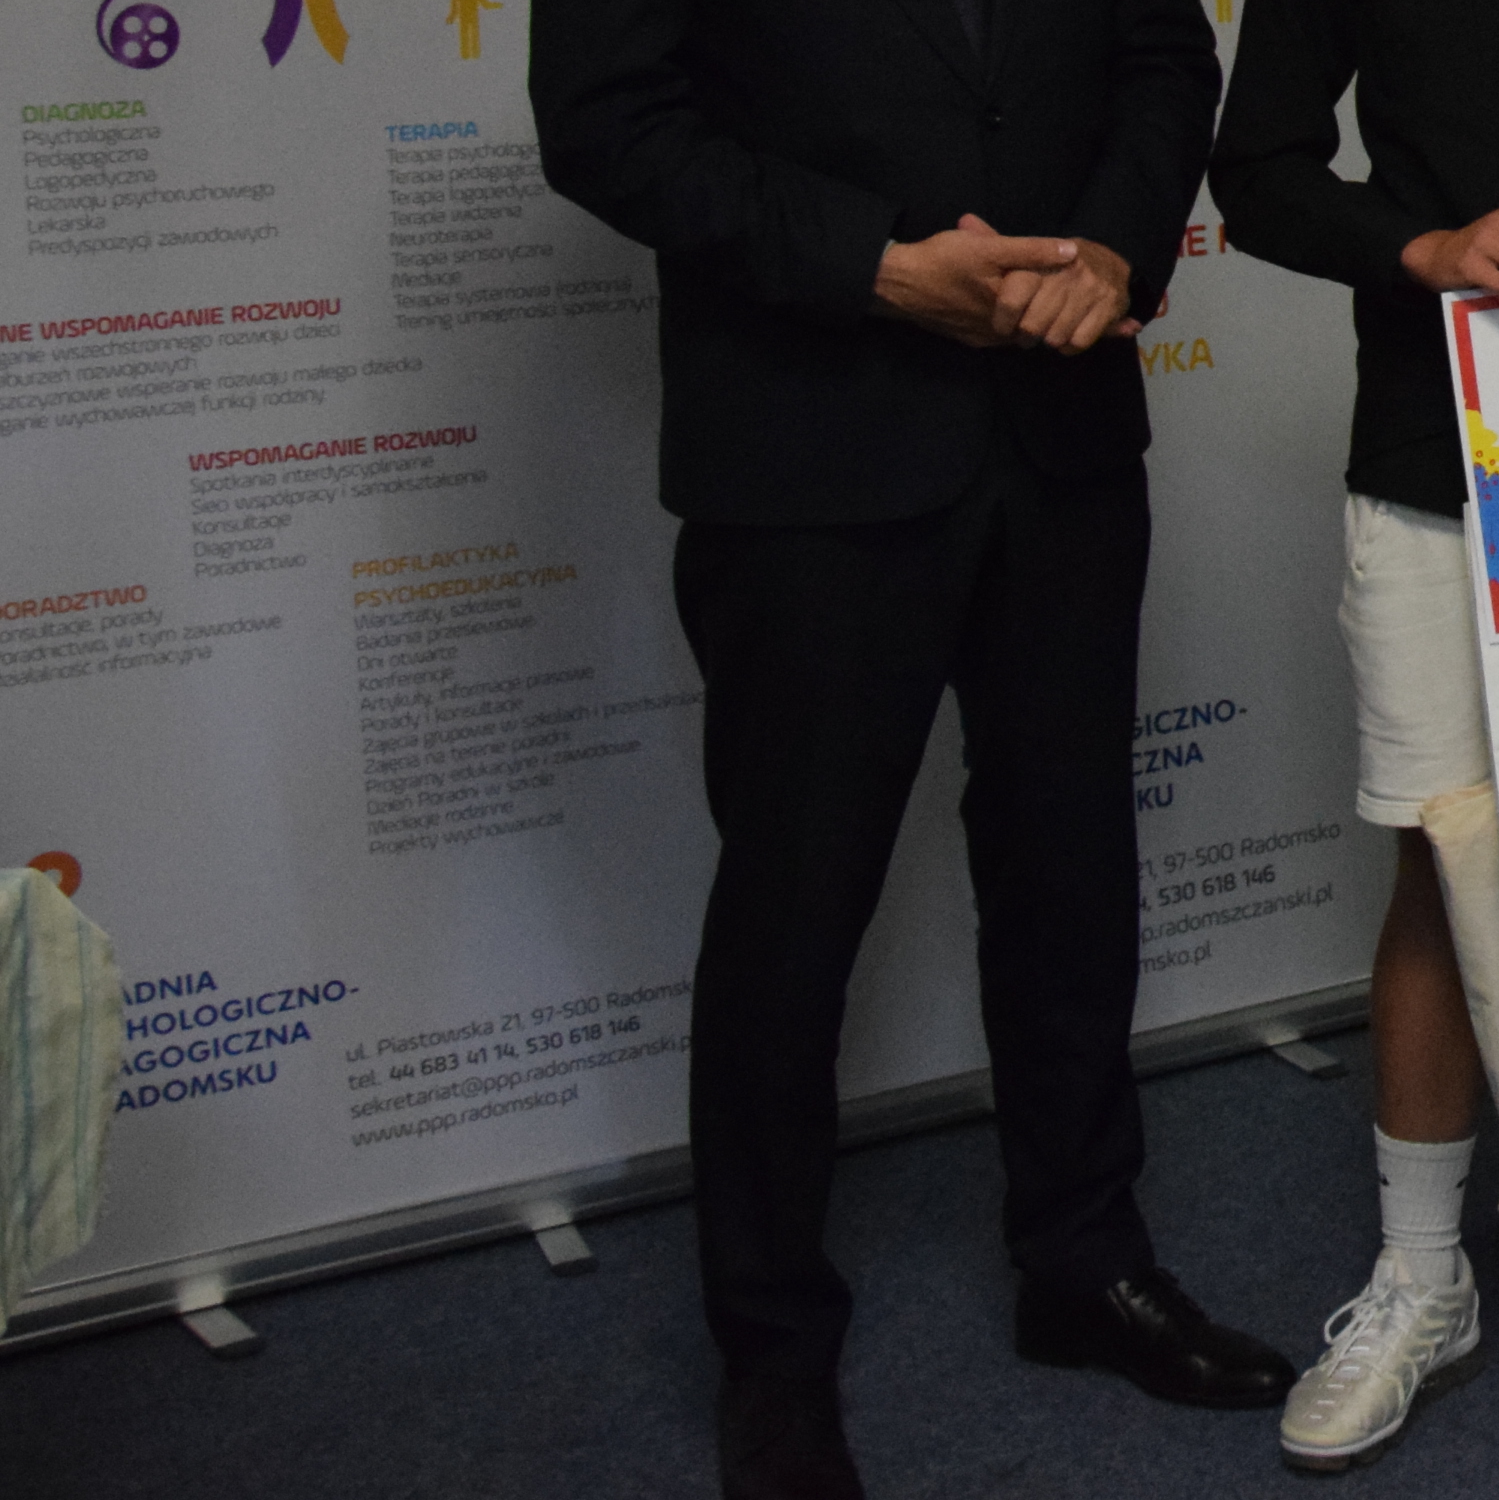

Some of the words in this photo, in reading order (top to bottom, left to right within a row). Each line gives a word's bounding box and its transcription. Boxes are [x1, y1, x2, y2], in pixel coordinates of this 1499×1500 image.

[22, 100, 147, 123] DIAGNOZA
[385, 121, 478, 142] TERAPIA
[41, 306, 225, 341] WSPOMAGANIE
[232, 297, 341, 325] ROZWOJU
[189, 436, 368, 472] WSPOMAGANIE
[374, 425, 478, 454] ROZWOJU
[352, 542, 519, 579] PROFILAKTYKA
[1164, 843, 1233, 875] 97-500
[1240, 822, 1341, 856] Radomsko
[1158, 882, 1196, 907] 530
[1202, 873, 1236, 897] 618
[1243, 865, 1275, 886] 146
[1141, 883, 1334, 944] p.radomszczanski.pl
[127, 980, 360, 1040] HOLOGICZNO-
[606, 979, 693, 1008] Radomsk
[121, 1021, 312, 1076] GOGICZNA
[348, 1070, 382, 1091] tel.
[389, 1063, 416, 1080] 44
[420, 1053, 460, 1076] 683
[467, 1047, 487, 1066] 41
[494, 1042, 519, 1062] 14,
[526, 1031, 563, 1055] 530
[569, 1023, 603, 1045] 618
[608, 1015, 641, 1036] 146
[115, 1061, 277, 1112] ADOMSKU
[350, 1033, 692, 1121] sekretariat@ppp.radomszczanski.p
